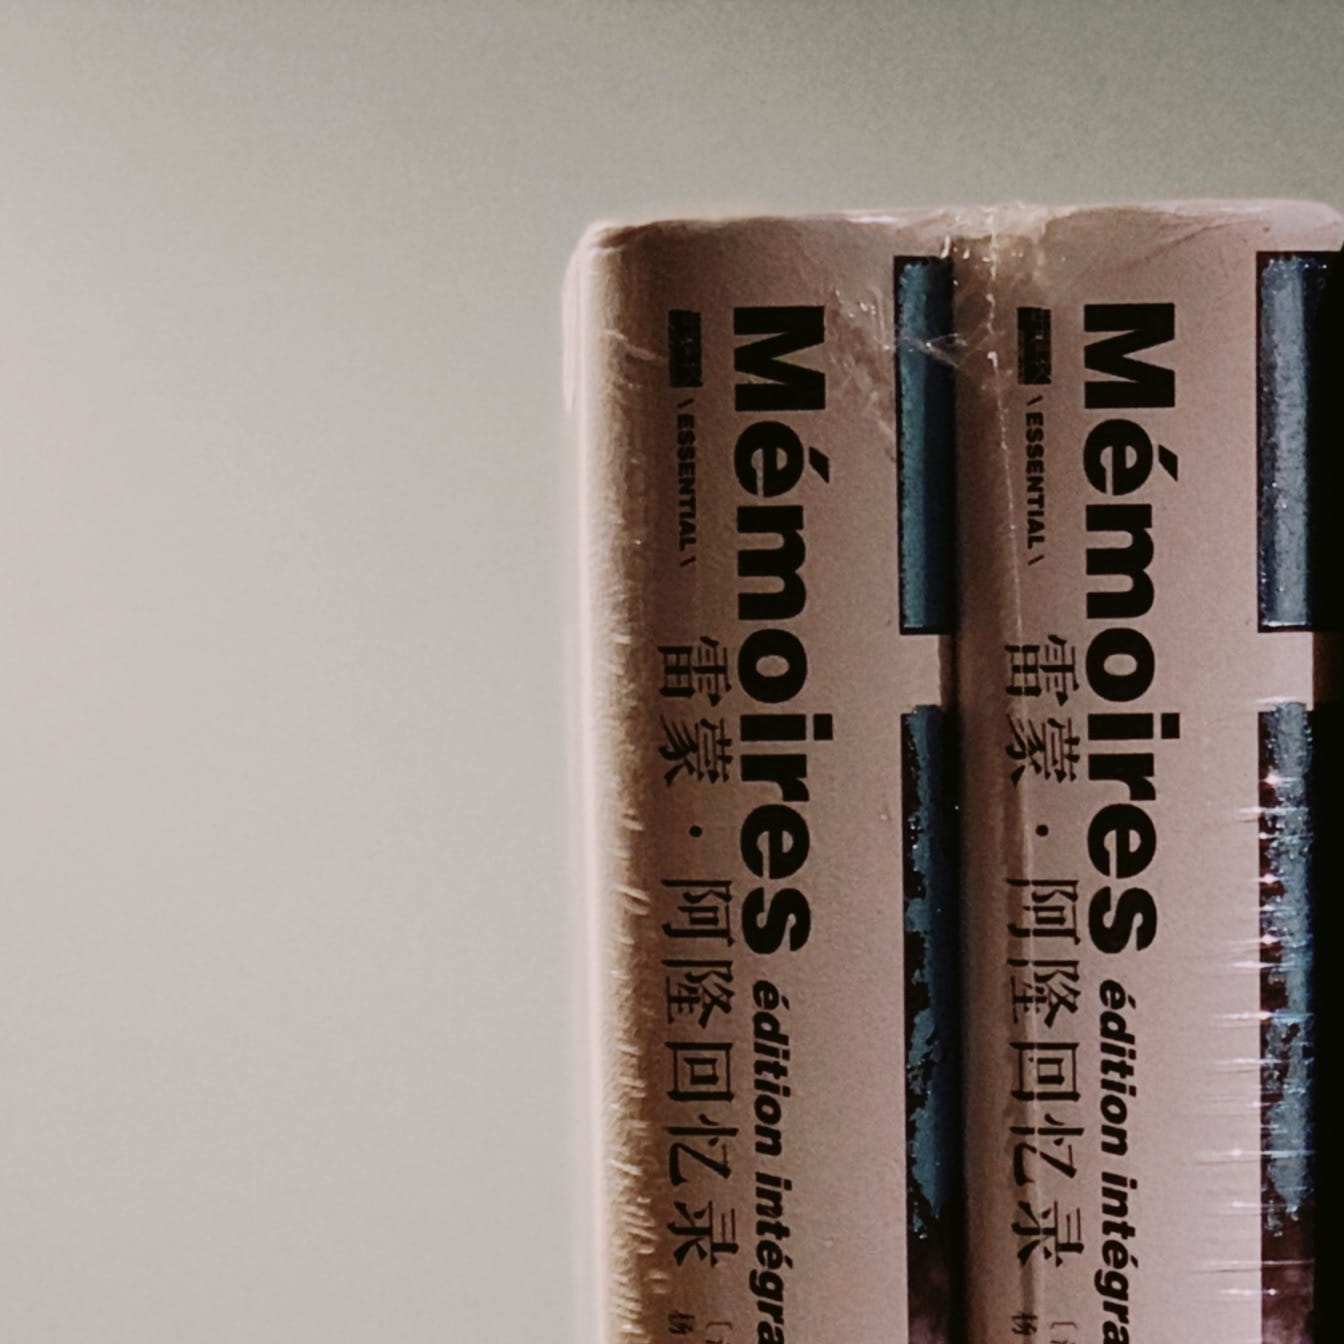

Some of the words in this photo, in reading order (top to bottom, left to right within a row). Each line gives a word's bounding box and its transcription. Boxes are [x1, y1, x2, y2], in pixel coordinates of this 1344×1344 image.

[676, 414, 696, 550] ESSENTIAL
[1025, 411, 1045, 550] ESSENTIAL
[732, 305, 834, 955] Mémoires
[1082, 303, 1181, 955] Mémoires
[753, 980, 791, 1156] édition
[1099, 979, 1136, 1156] édition
